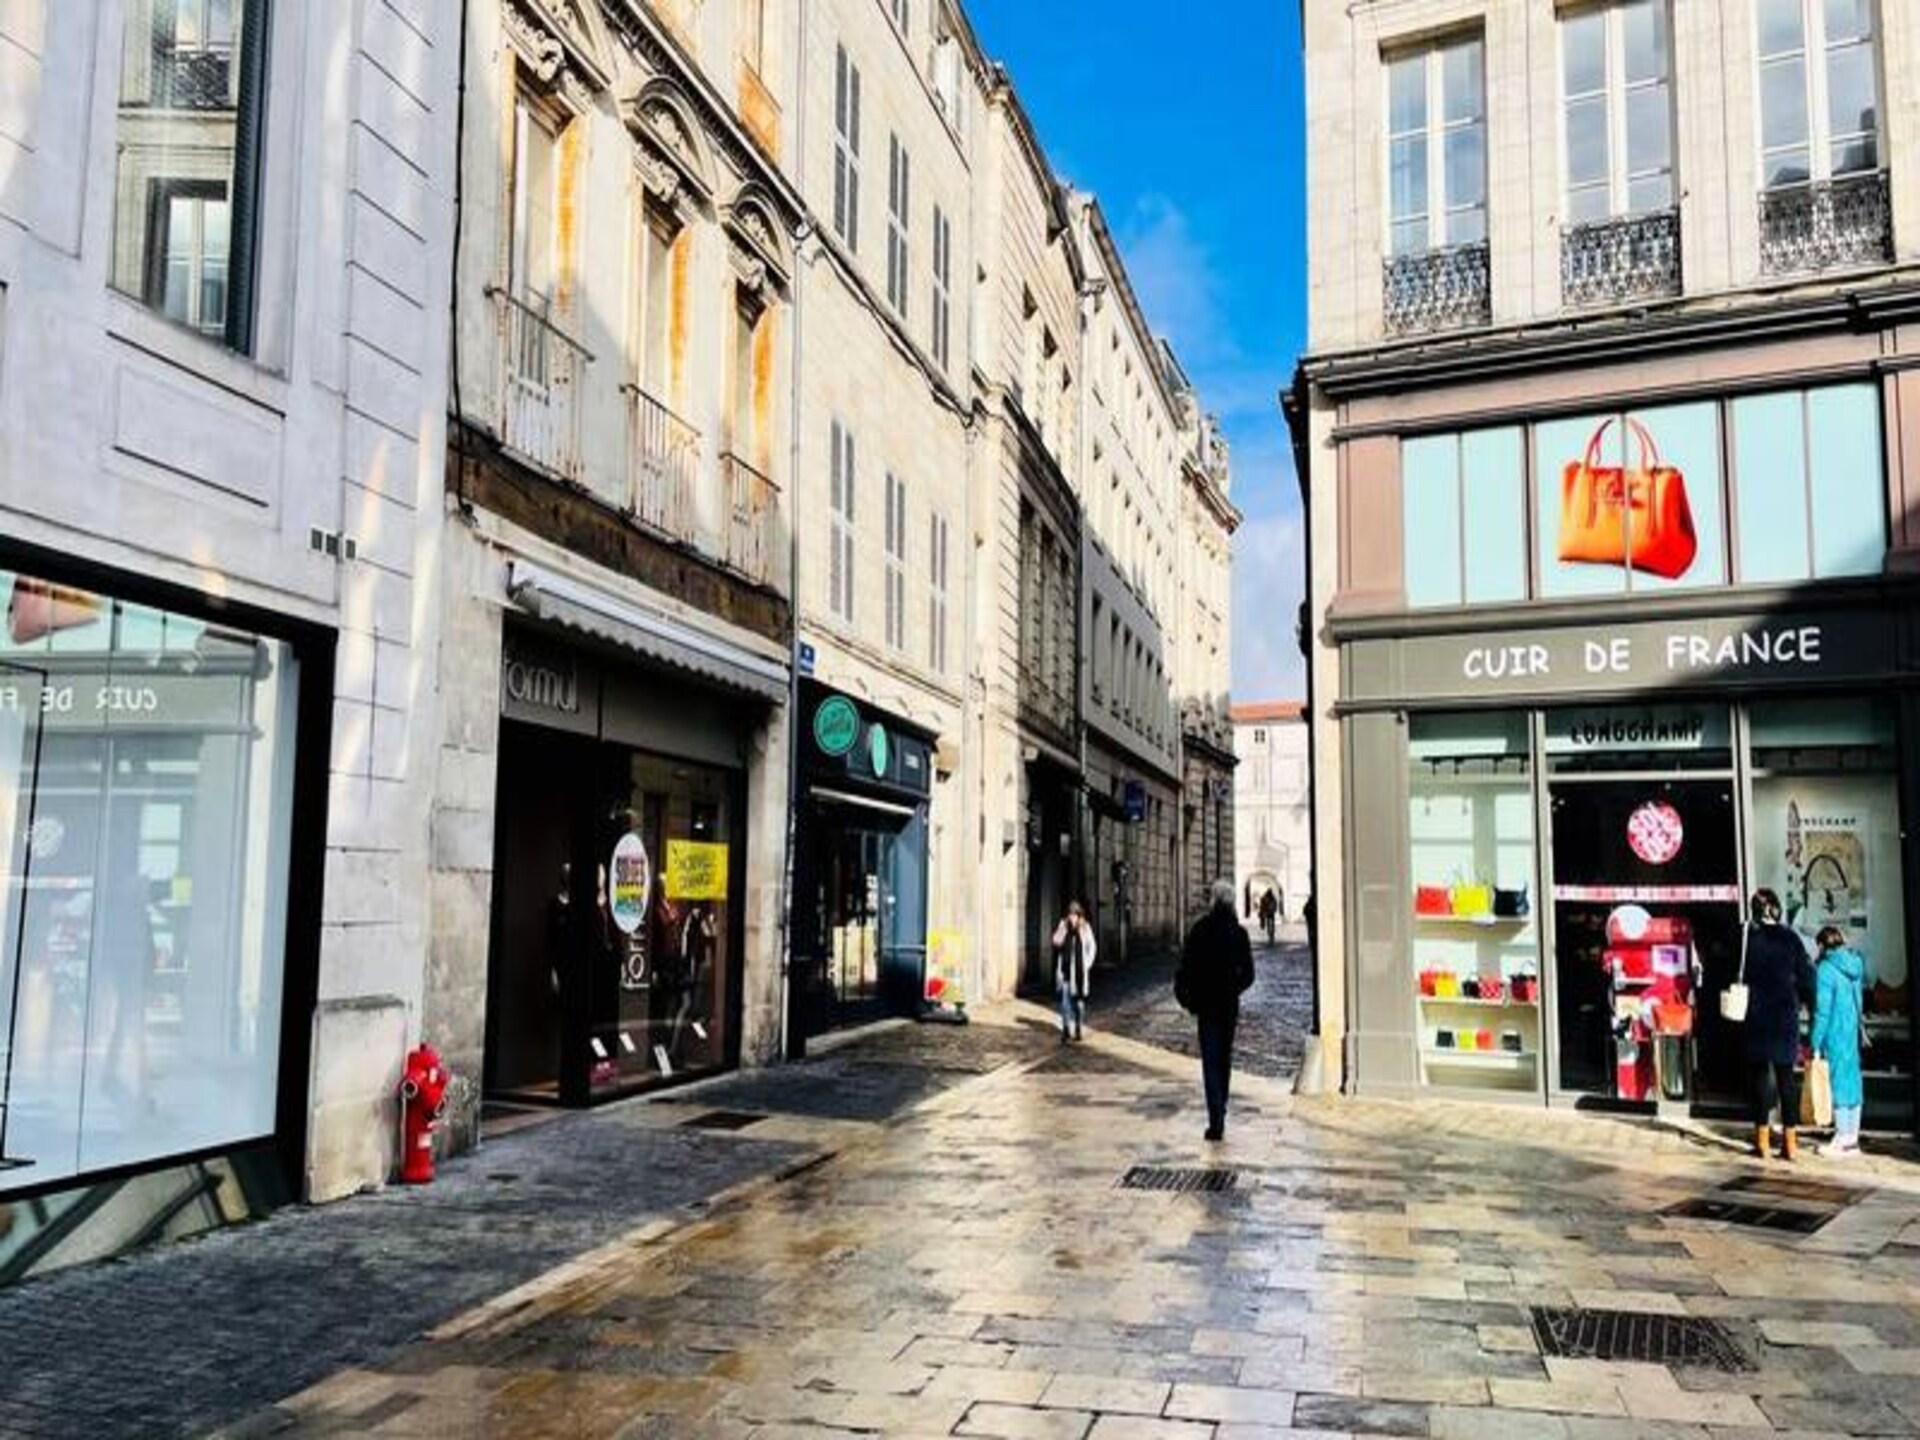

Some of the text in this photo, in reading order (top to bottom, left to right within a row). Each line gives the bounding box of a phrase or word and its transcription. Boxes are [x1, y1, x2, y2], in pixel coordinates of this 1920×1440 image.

[1463, 627, 1821, 678] CUIR DE FRANCE
